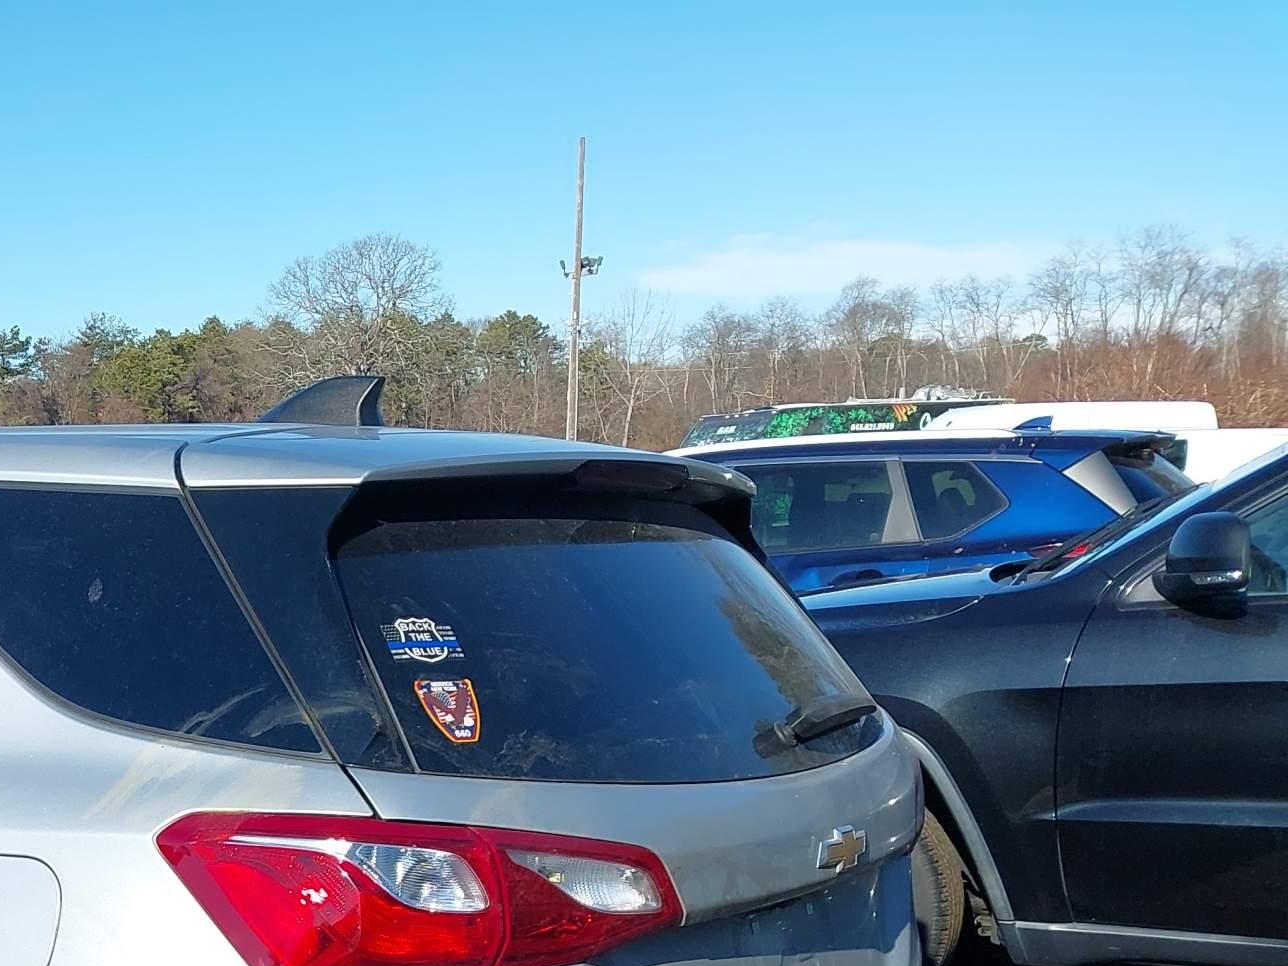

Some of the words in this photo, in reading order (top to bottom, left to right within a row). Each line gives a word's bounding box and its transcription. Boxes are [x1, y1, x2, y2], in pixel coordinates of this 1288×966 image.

[399, 622, 431, 631] BACK
[408, 632, 433, 641] THE
[412, 647, 443, 656] BLUE
